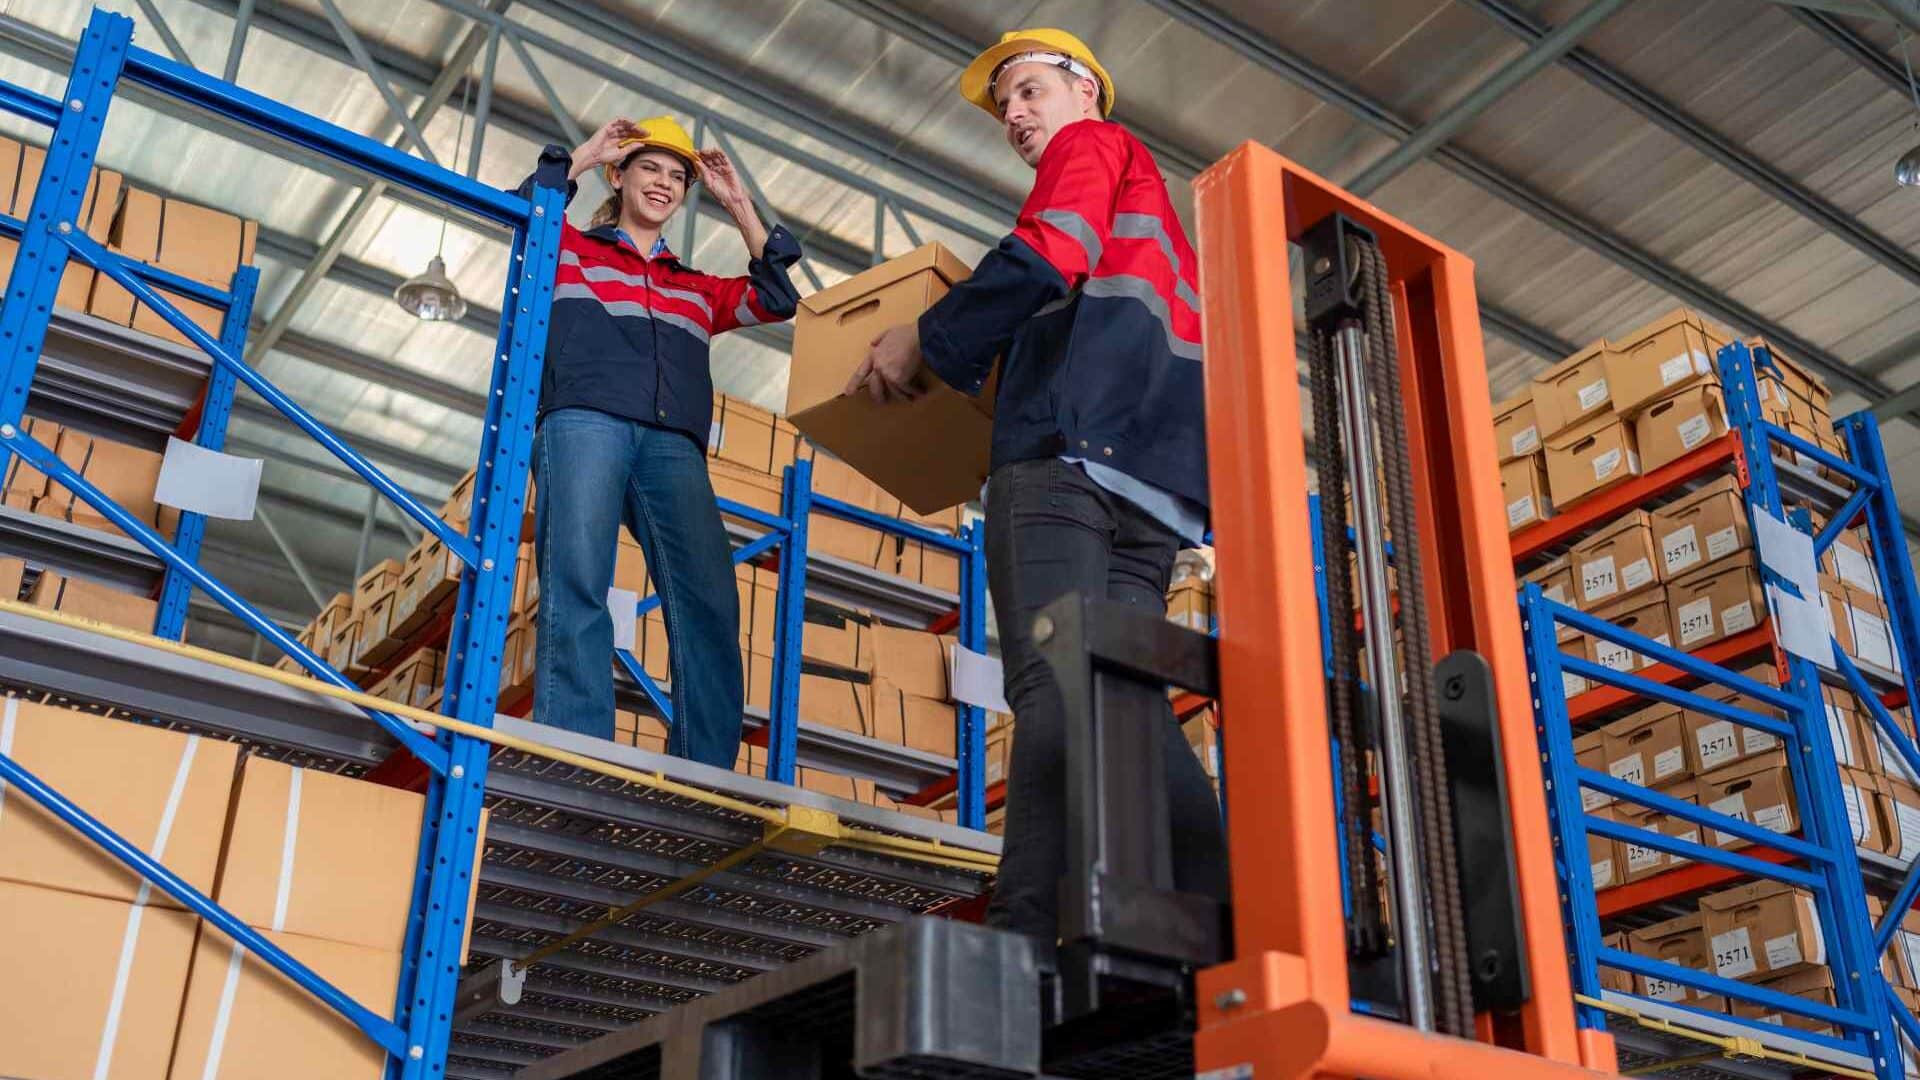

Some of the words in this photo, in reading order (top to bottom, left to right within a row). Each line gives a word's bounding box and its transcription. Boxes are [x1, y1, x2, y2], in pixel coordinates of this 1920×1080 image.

[1666, 541, 1696, 563] 2571
[1585, 572, 1613, 591] 2571
[1681, 614, 1709, 634] 2571
[1702, 736, 1733, 756] 2571
[1717, 946, 1749, 968] 2571
